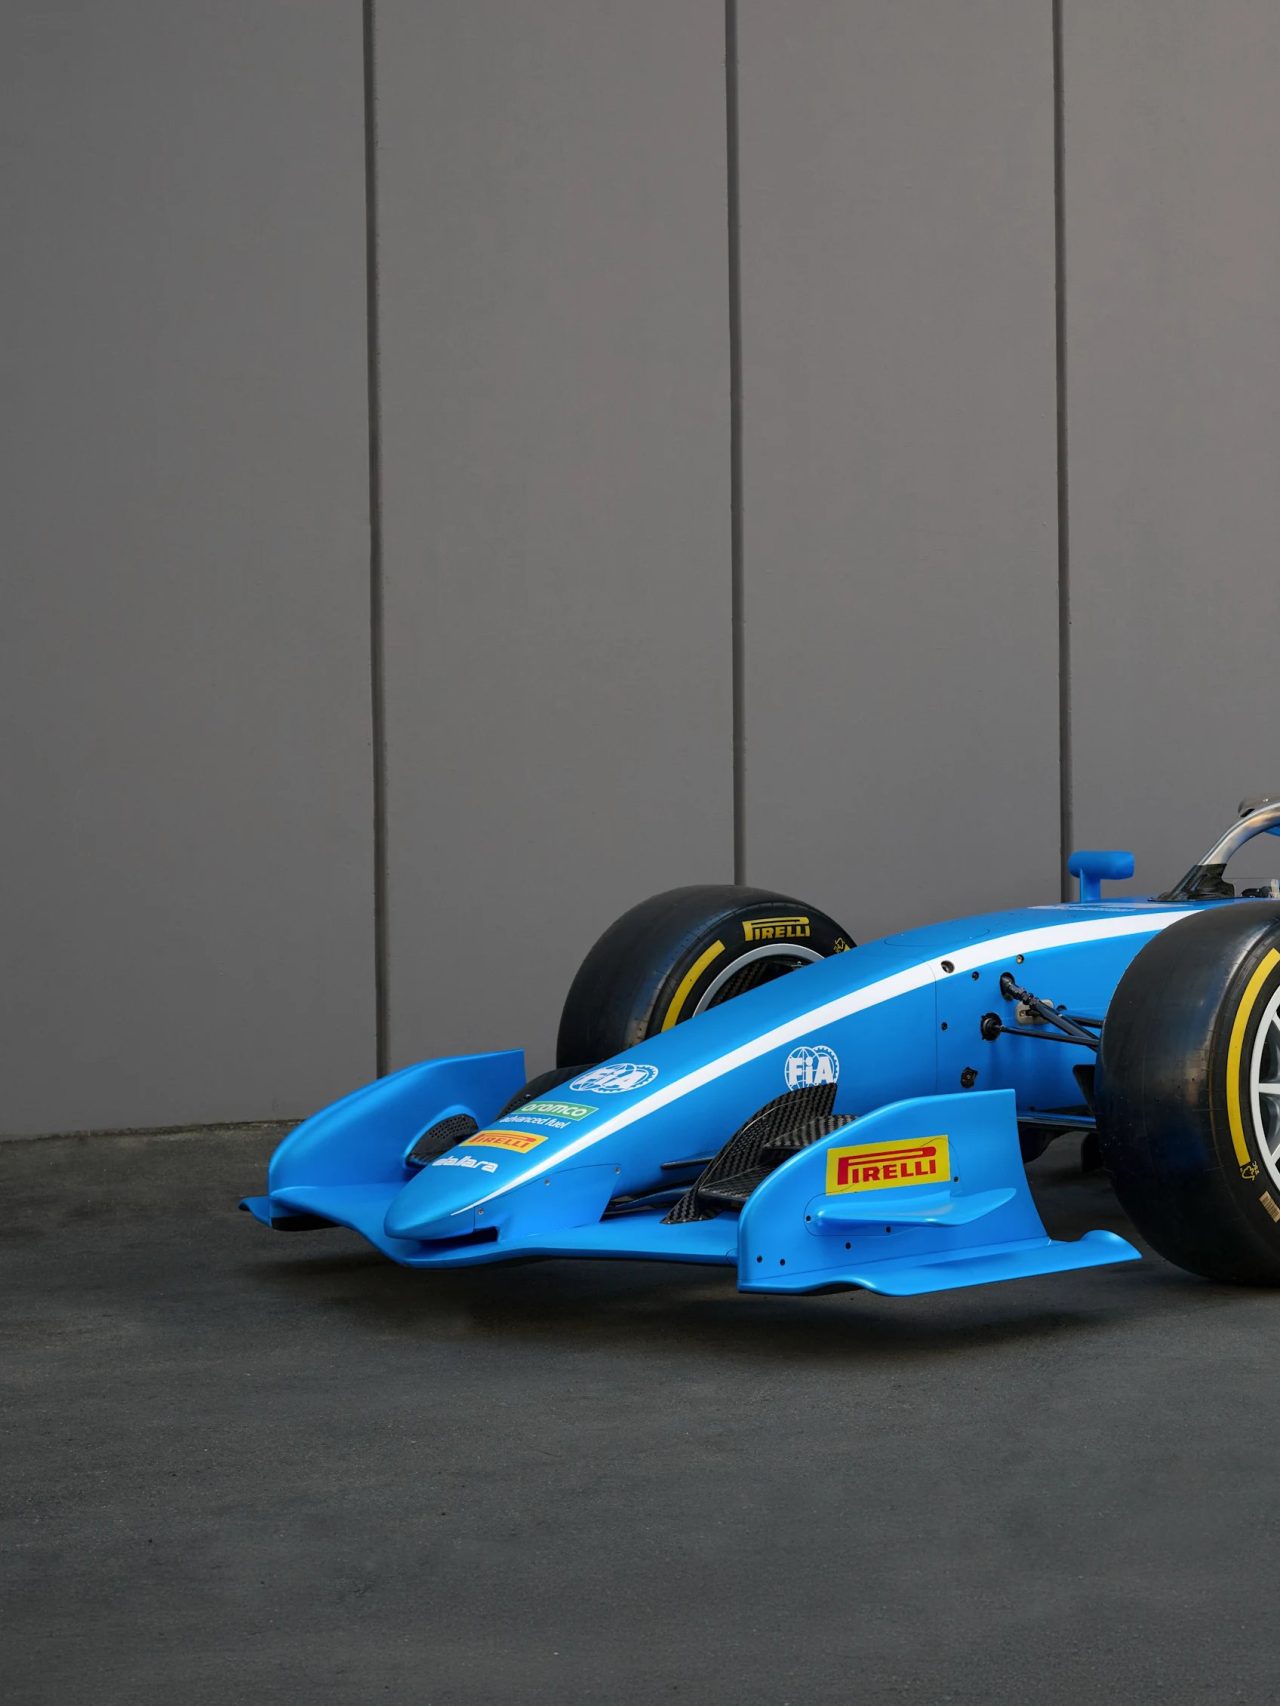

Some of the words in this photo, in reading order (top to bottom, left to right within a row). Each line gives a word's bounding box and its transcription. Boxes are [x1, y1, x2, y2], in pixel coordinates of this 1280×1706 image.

[742, 916, 811, 942] PIRELLI
[520, 1101, 588, 1118] aramco
[545, 1117, 571, 1130] fuel
[470, 1132, 537, 1149] PIRELLI
[836, 1146, 937, 1186] PIRELLI
